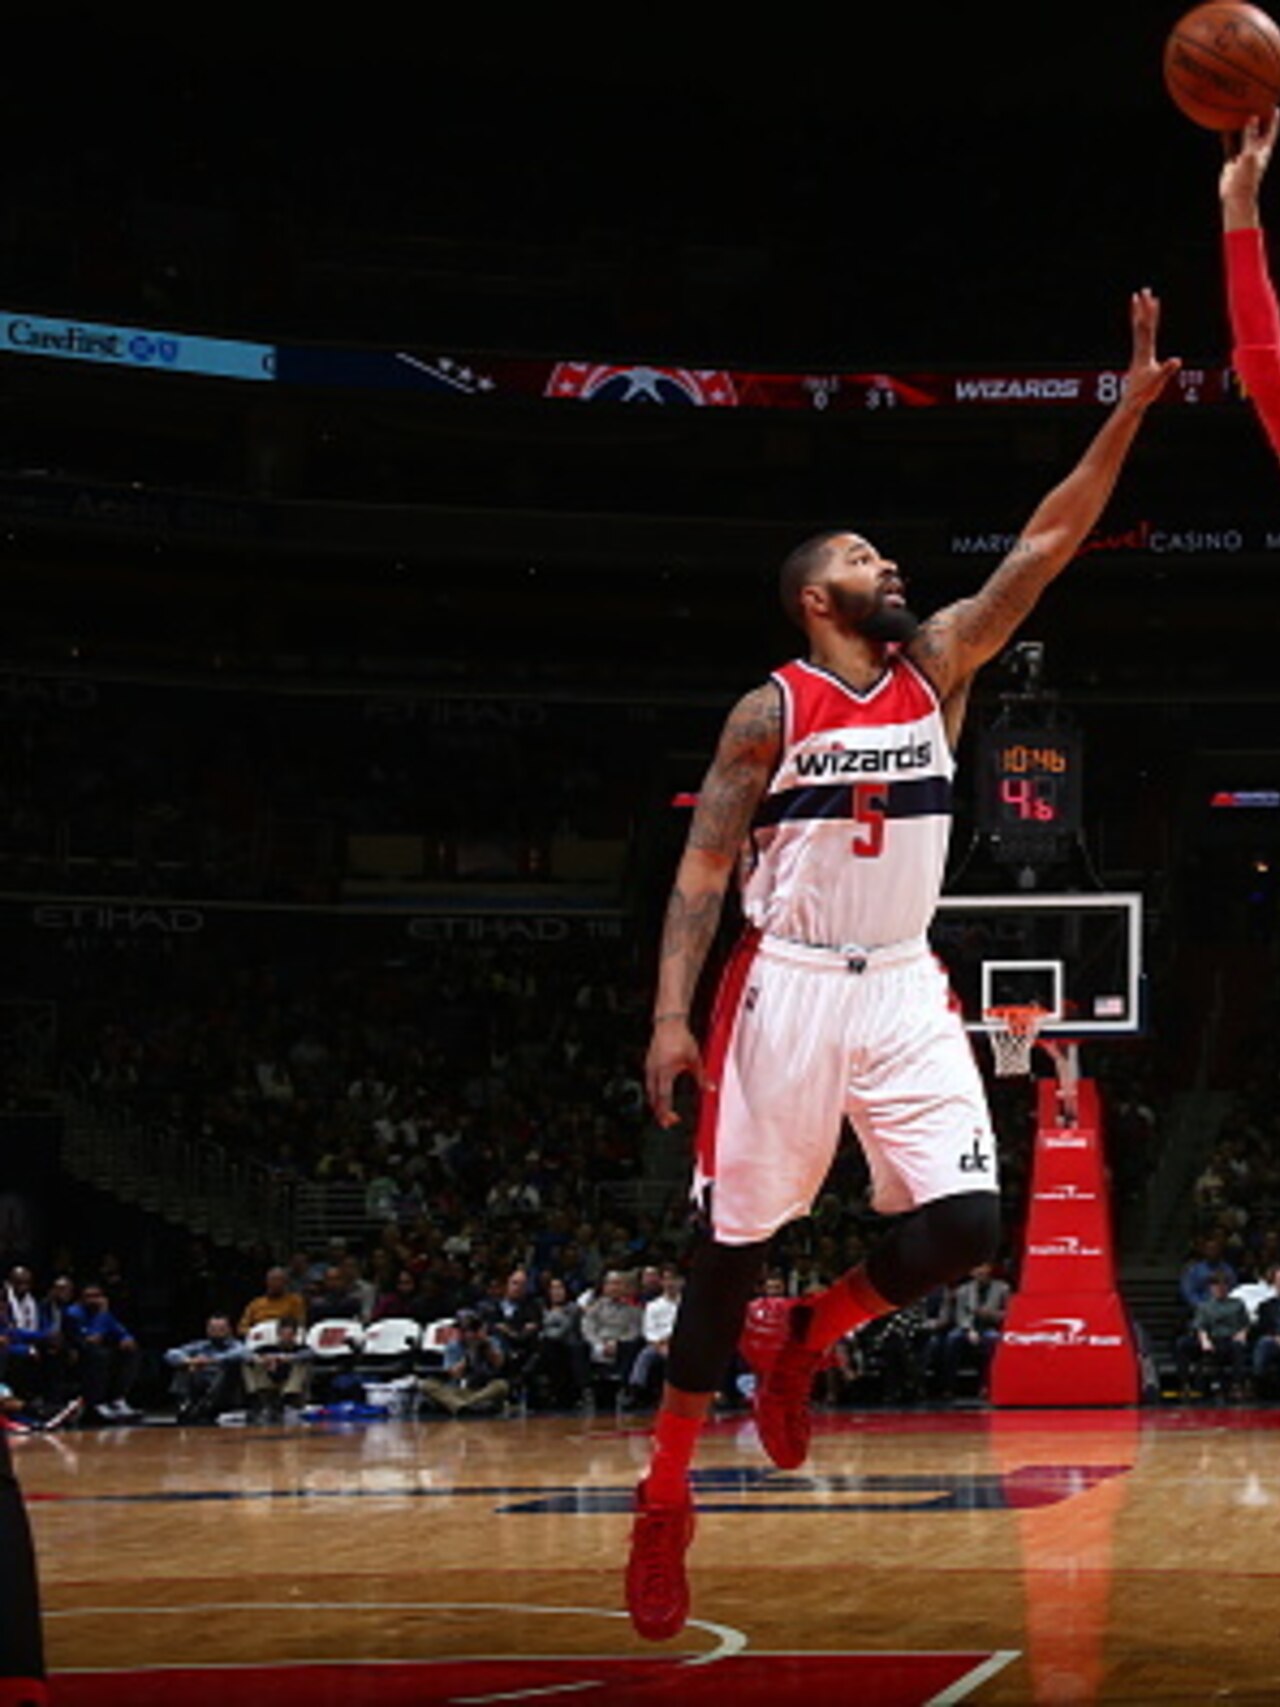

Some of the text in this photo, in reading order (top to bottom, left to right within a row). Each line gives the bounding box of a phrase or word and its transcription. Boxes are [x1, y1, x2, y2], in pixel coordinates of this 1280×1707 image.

[8, 319, 124, 358] CareFirst
[953, 369, 1127, 405] WIZARDS 8
[951, 534, 1015, 554] MARY
[1150, 529, 1244, 554] CASINO
[852, 783, 889, 857] 5
[32, 905, 205, 933] ETIHAD
[407, 918, 571, 942] ETIHAD
